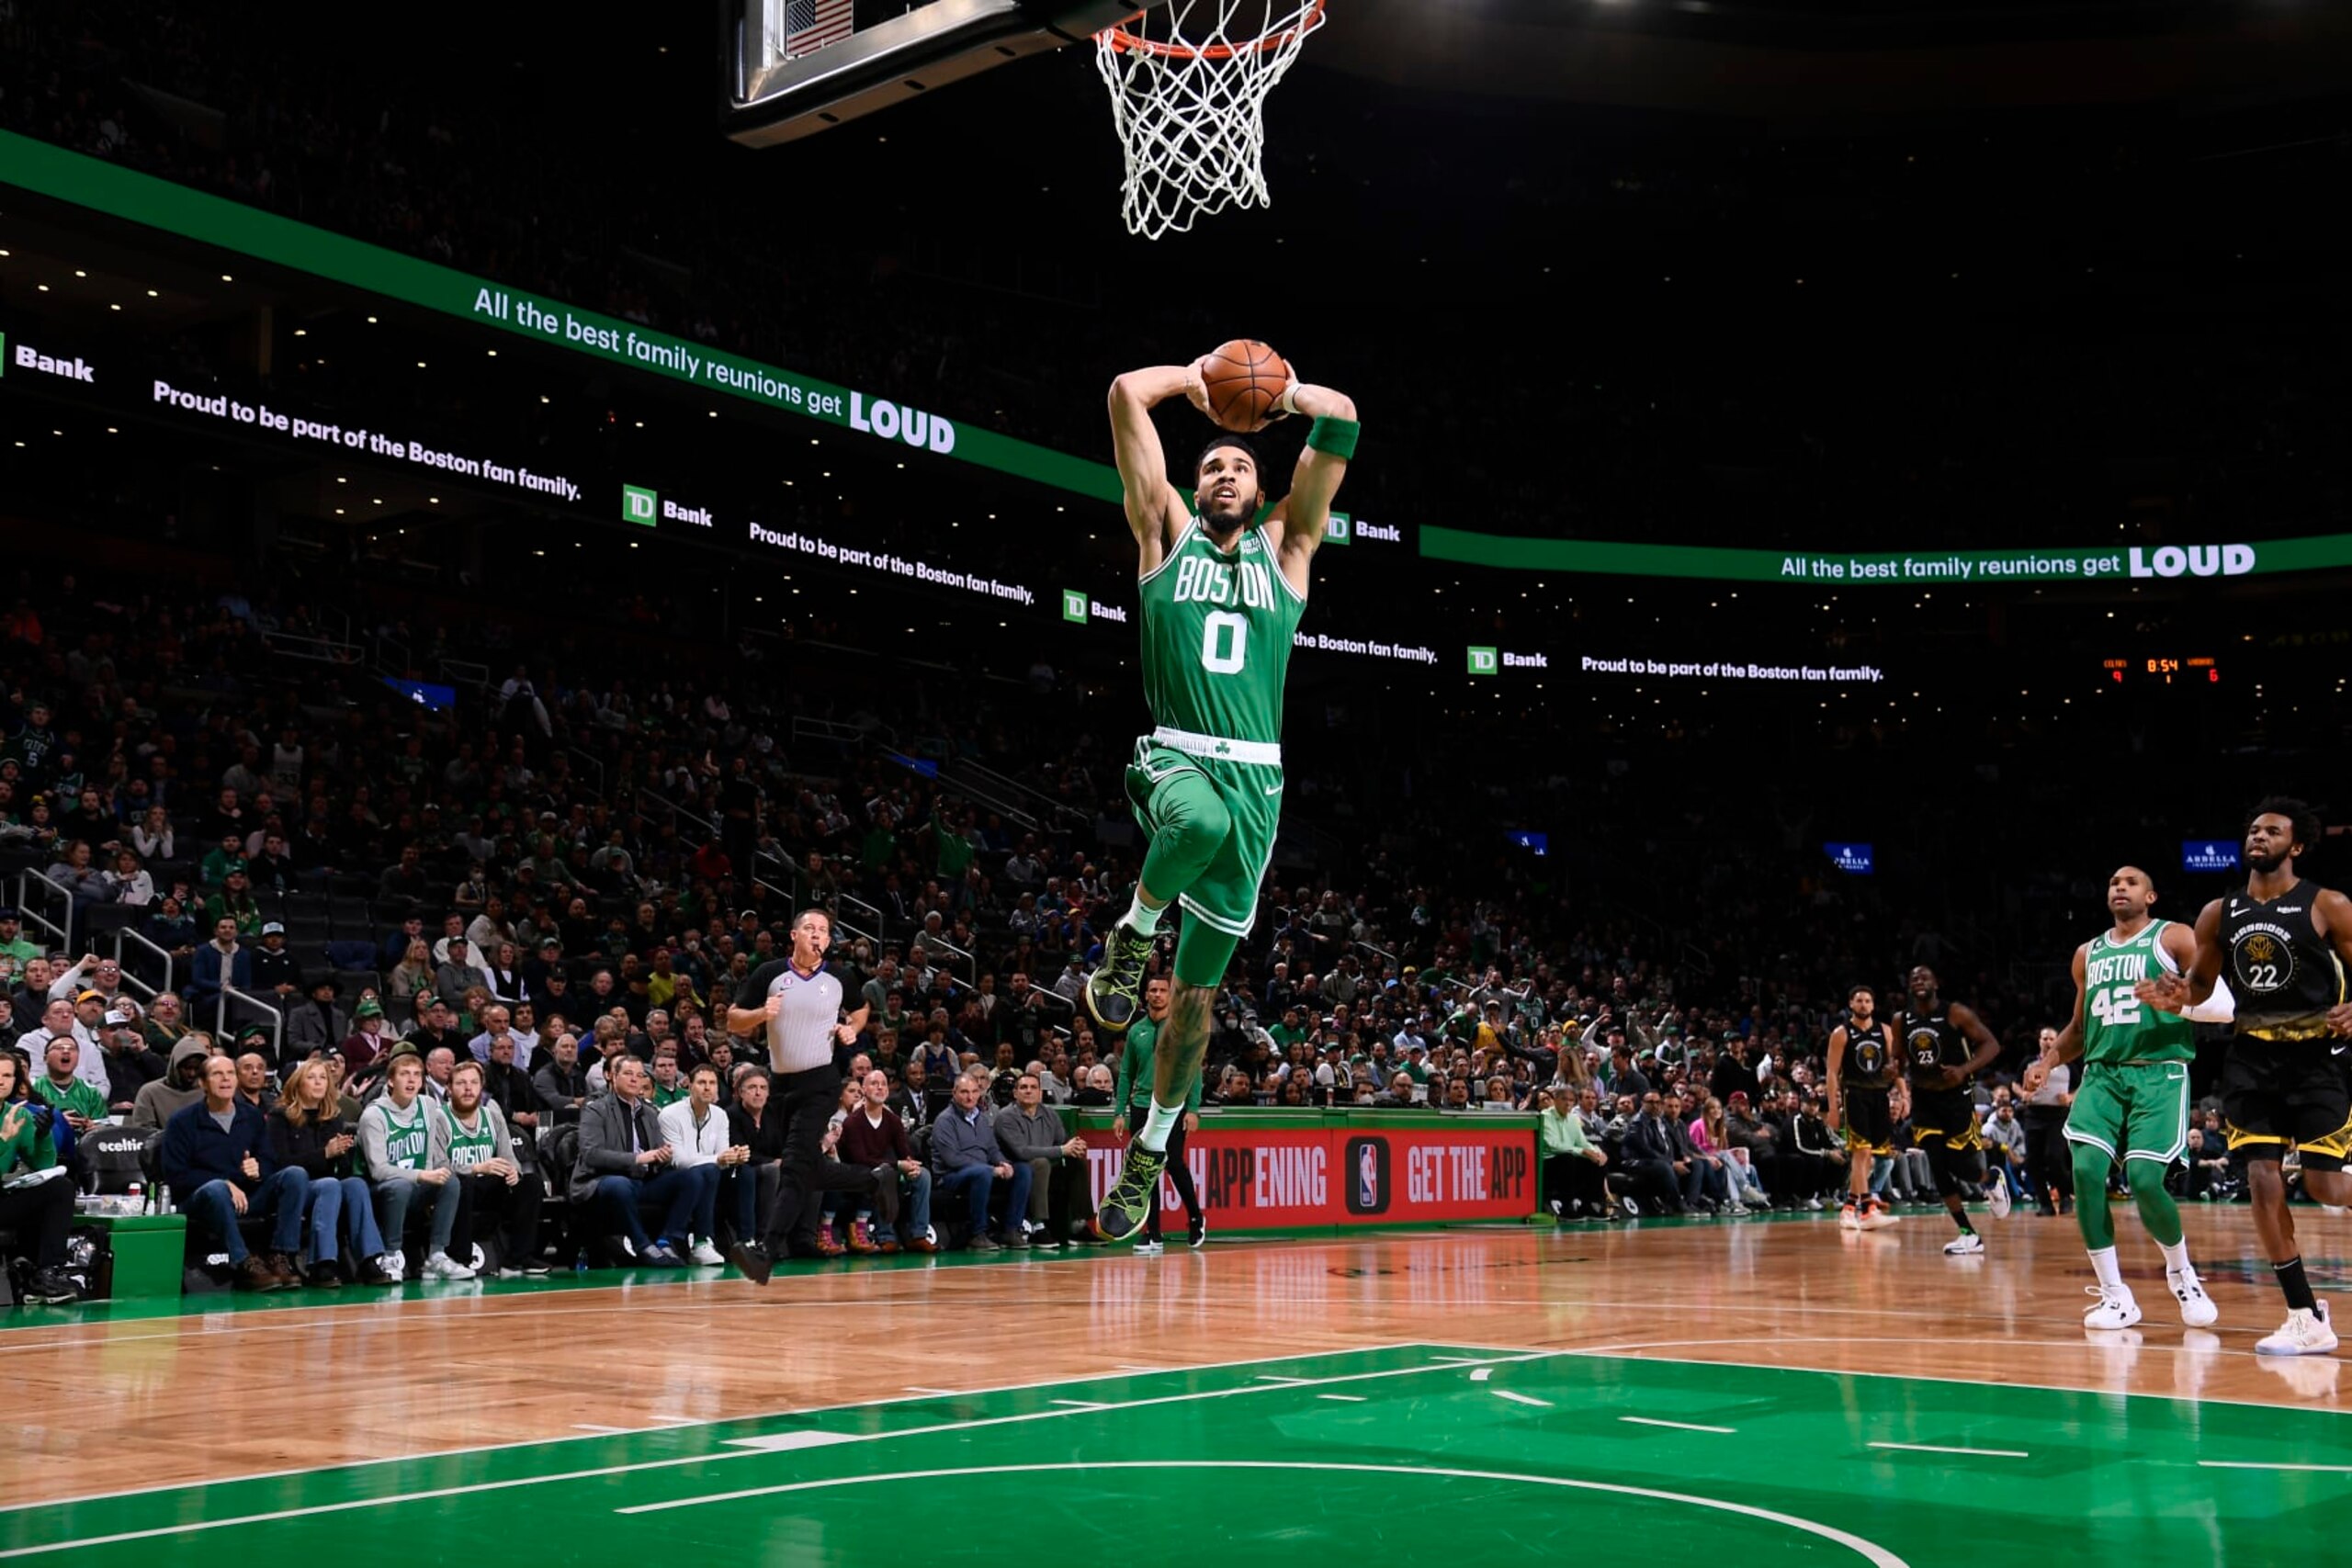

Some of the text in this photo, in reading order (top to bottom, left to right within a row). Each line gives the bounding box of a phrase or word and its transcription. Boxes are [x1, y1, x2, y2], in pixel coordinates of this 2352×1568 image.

[15, 344, 95, 383] Bank
[474, 288, 956, 455] All the best family reunions get LOUD
[153, 379, 582, 502] Proud to be part of the Boston fan family.
[627, 491, 713, 527] TD Bank
[1355, 520, 1400, 542] Bank
[749, 522, 1035, 606] Proud to be part of the Boston fan family.
[1781, 543, 2256, 579] All the best family reunions get LOUD
[1173, 555, 1276, 613] BOSTON
[1091, 601, 1126, 623] Bank
[1202, 610, 1248, 675] 0
[1292, 631, 1438, 665] the Boston fan family.
[1502, 651, 1548, 668] Bank
[1581, 656, 1884, 682] Proud to be part of the Boston fan family.
[2148, 660, 2178, 672] 8:54
[2087, 953, 2147, 991] BOSTON
[2249, 964, 2278, 988] 22
[2090, 986, 2142, 1027] 42
[1917, 1050, 1934, 1065] 23
[1189, 1145, 1327, 1210] HAPPENING
[1408, 1145, 1526, 1203] GET THE APP
